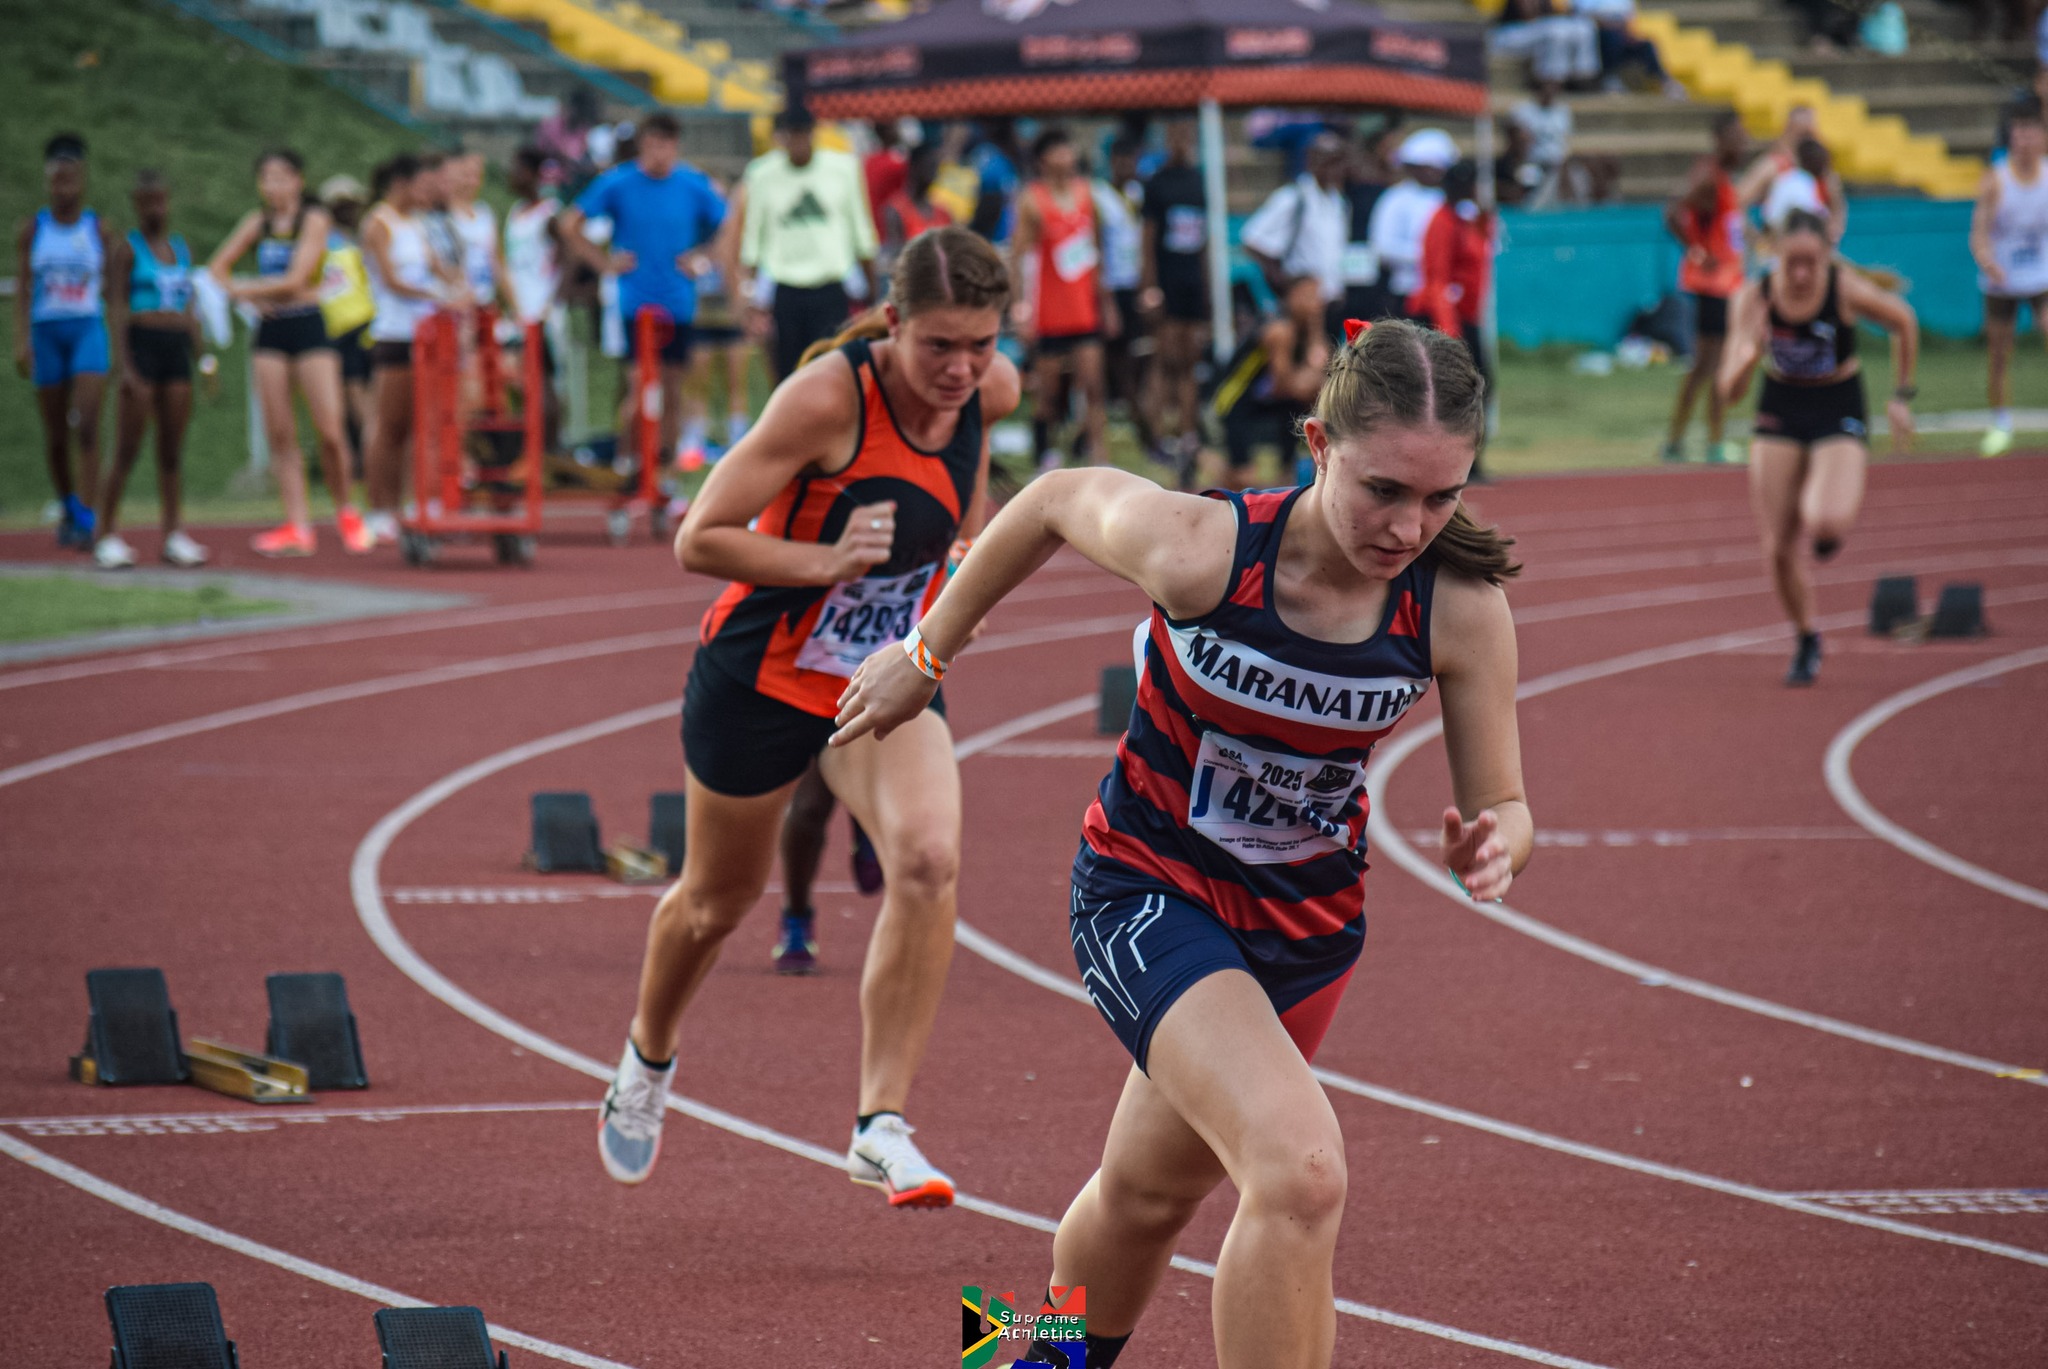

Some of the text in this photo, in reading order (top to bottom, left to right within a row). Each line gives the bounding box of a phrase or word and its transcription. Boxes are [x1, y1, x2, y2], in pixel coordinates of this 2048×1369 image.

[833, 600, 914, 644] 4293
[1192, 765, 1215, 817] J
[1257, 762, 1305, 791] 2025
